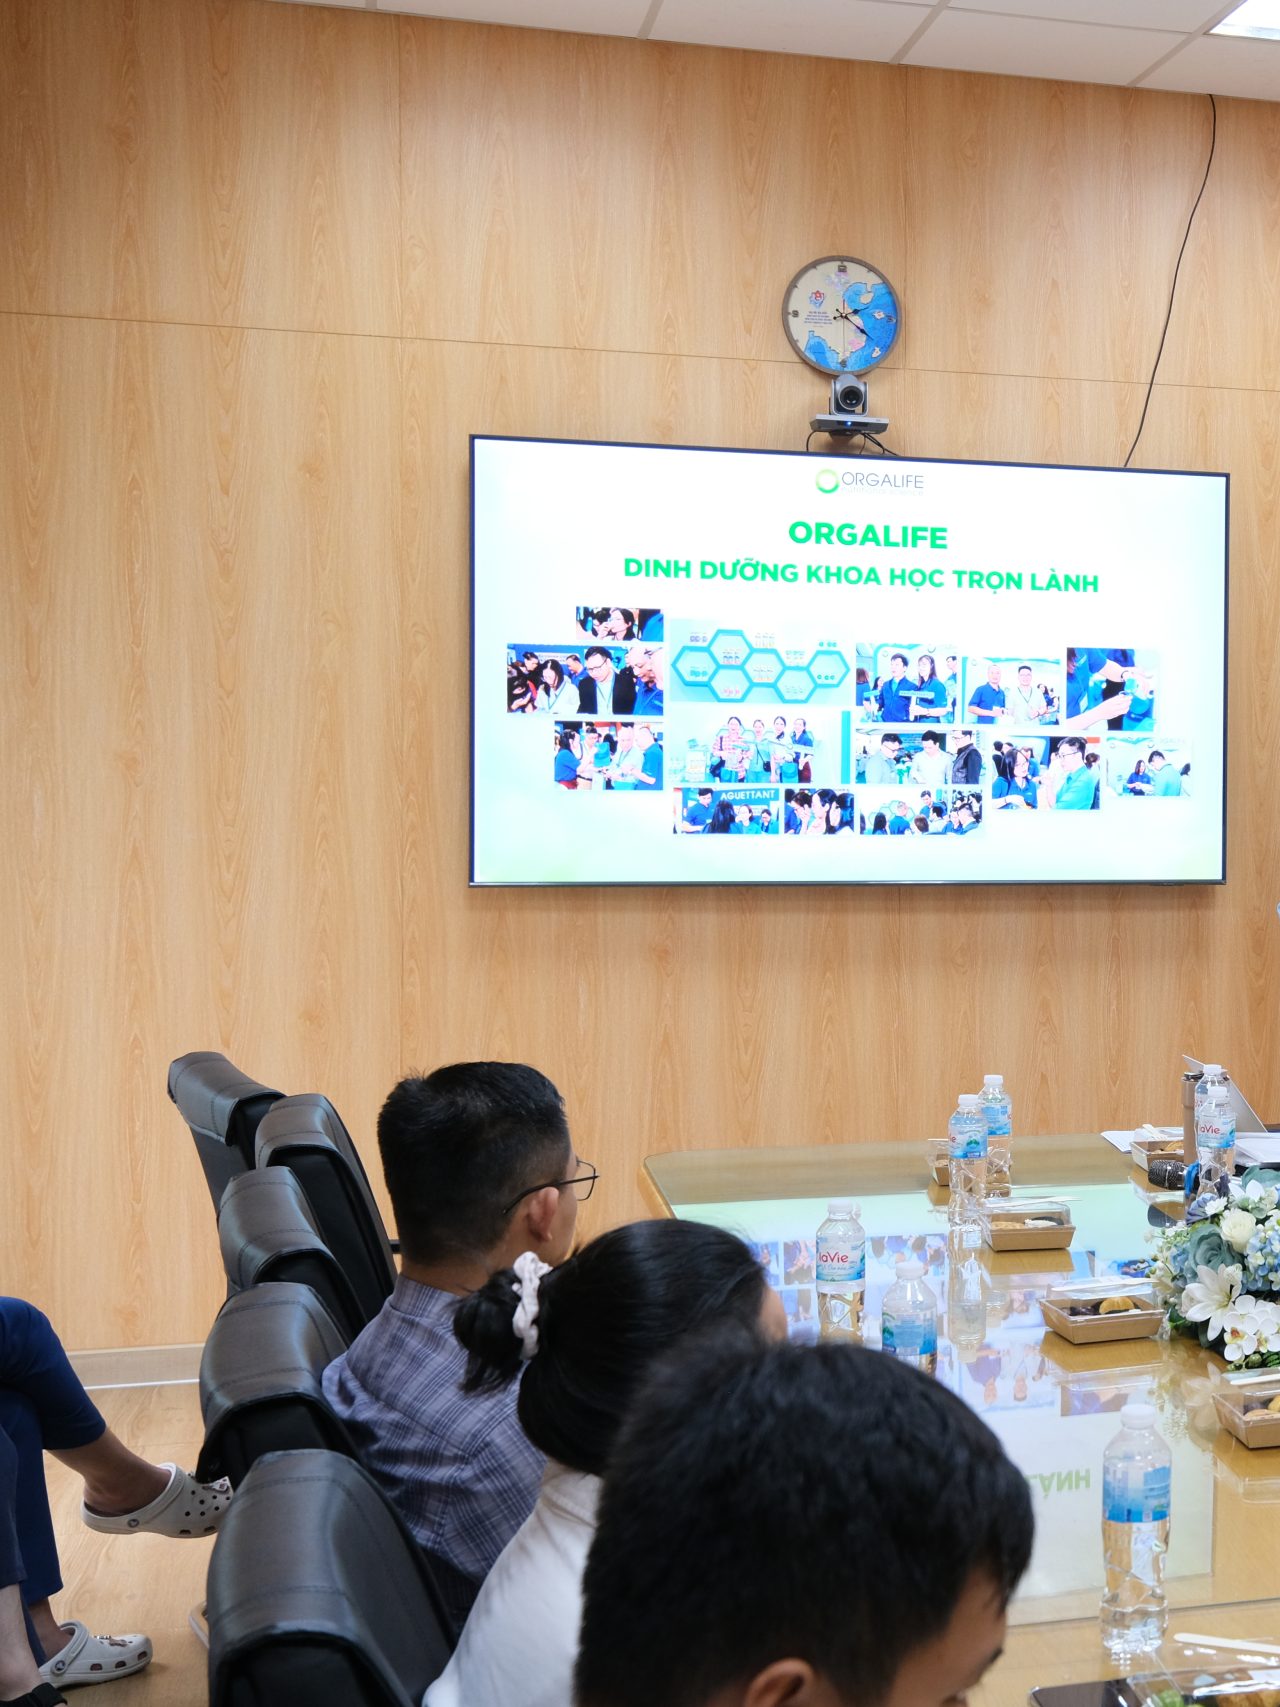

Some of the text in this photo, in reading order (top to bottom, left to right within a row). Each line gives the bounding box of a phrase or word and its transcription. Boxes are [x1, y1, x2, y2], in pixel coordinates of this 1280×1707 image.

[842, 471, 924, 489] ORGALIFE
[789, 520, 948, 549] ORGALIFE
[624, 557, 1099, 595] DINH DƯỠNG KHOA HỌC TRỌN LÀNH
[720, 790, 775, 801] AGUETTANT
[818, 1251, 849, 1263] laVie
